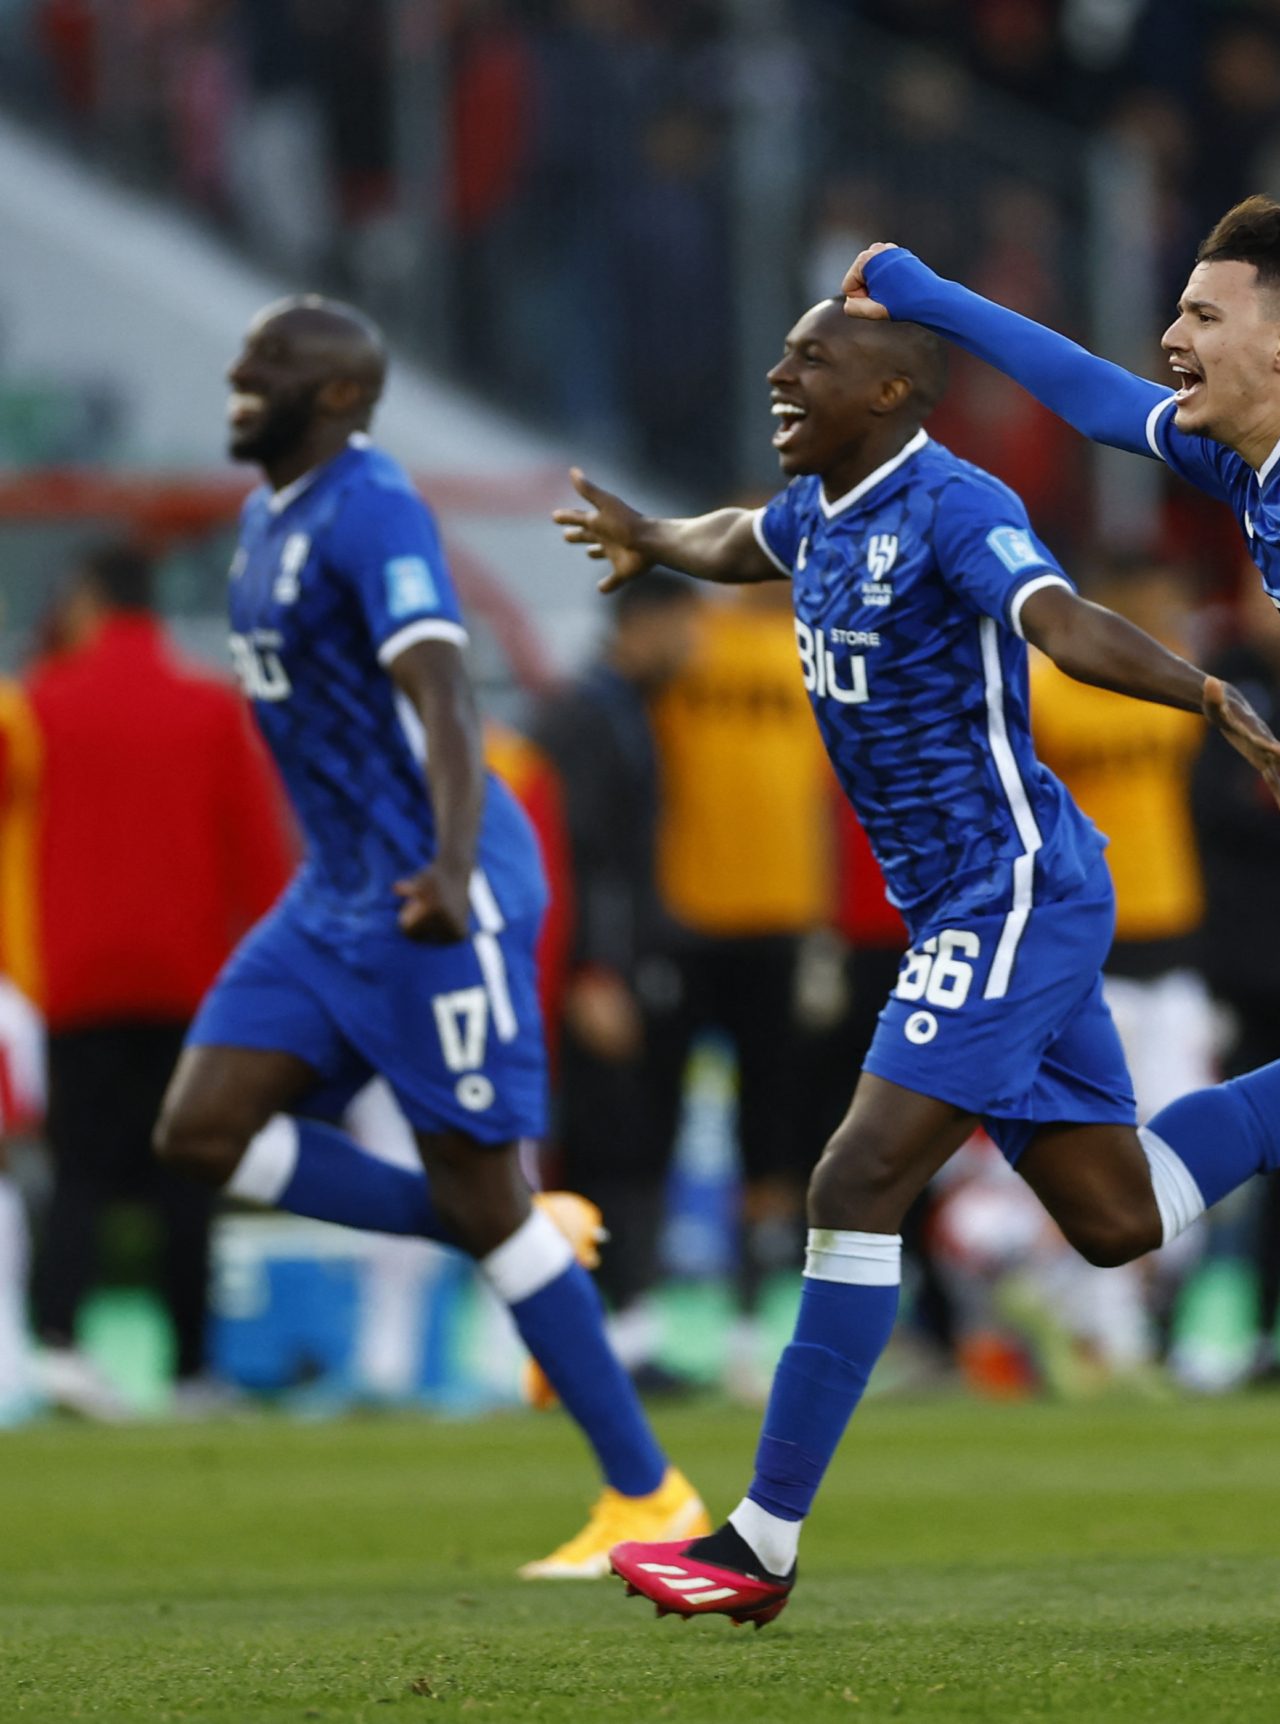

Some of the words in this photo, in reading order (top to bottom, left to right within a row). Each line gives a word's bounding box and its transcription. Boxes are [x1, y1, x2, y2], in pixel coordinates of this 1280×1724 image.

[830, 627, 881, 647] STORE
[896, 928, 981, 1010] 66
[431, 984, 488, 1074] 17
